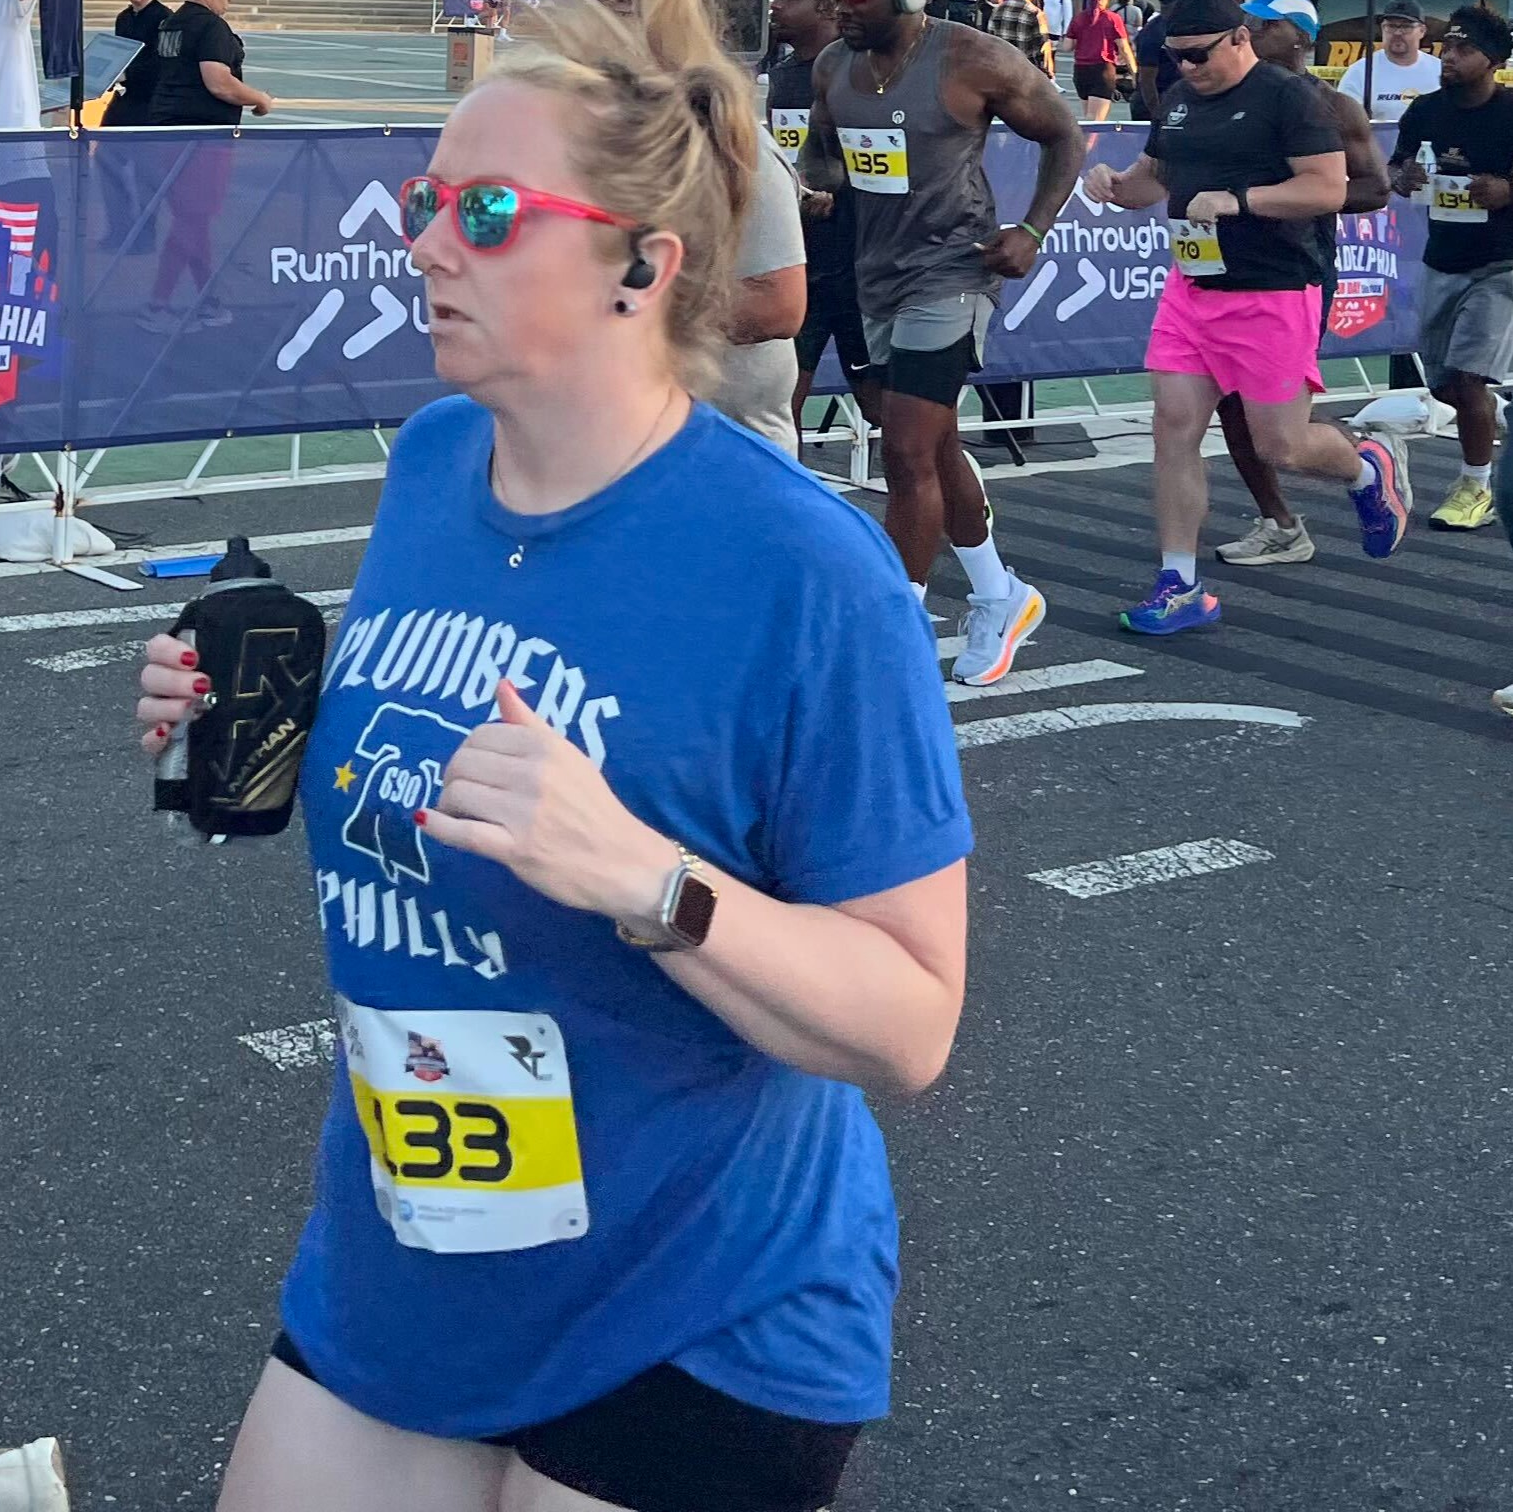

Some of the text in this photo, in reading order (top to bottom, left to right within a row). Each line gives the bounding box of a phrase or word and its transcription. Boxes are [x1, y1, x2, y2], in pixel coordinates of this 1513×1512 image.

[852, 151, 890, 175] 135
[1177, 240, 1200, 260] 70
[379, 765, 419, 808] 690
[372, 1097, 513, 1183] 133
